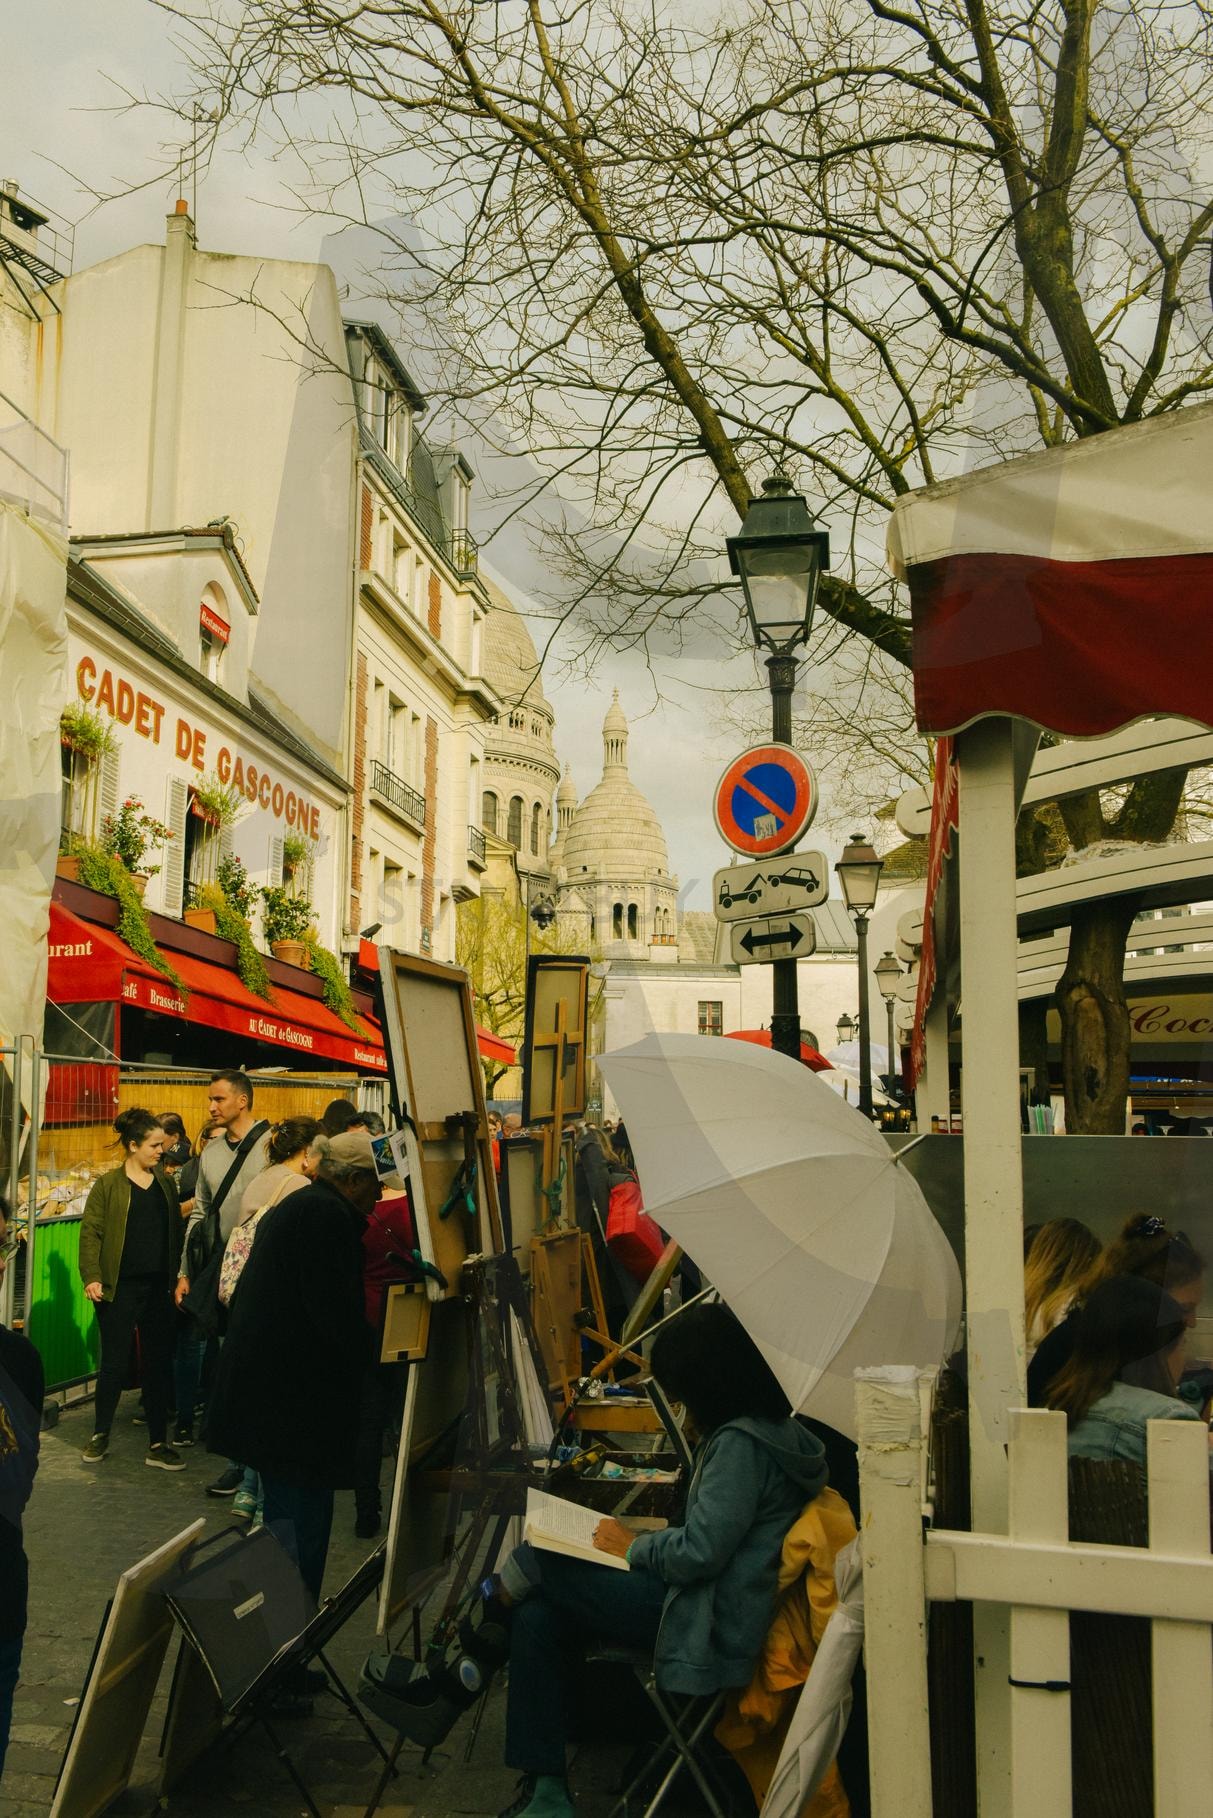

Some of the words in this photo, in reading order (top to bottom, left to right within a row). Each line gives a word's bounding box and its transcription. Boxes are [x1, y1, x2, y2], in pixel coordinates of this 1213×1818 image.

[76, 656, 165, 744] CADET
[175, 718, 206, 772] DE
[216, 747, 320, 841] GASCOGNE
[150, 988, 185, 1013] Brasserie
[258, 1018, 277, 1039] CADET
[286, 1026, 313, 1049] GASCOGNE
[1129, 1005, 1213, 1034] Coc
